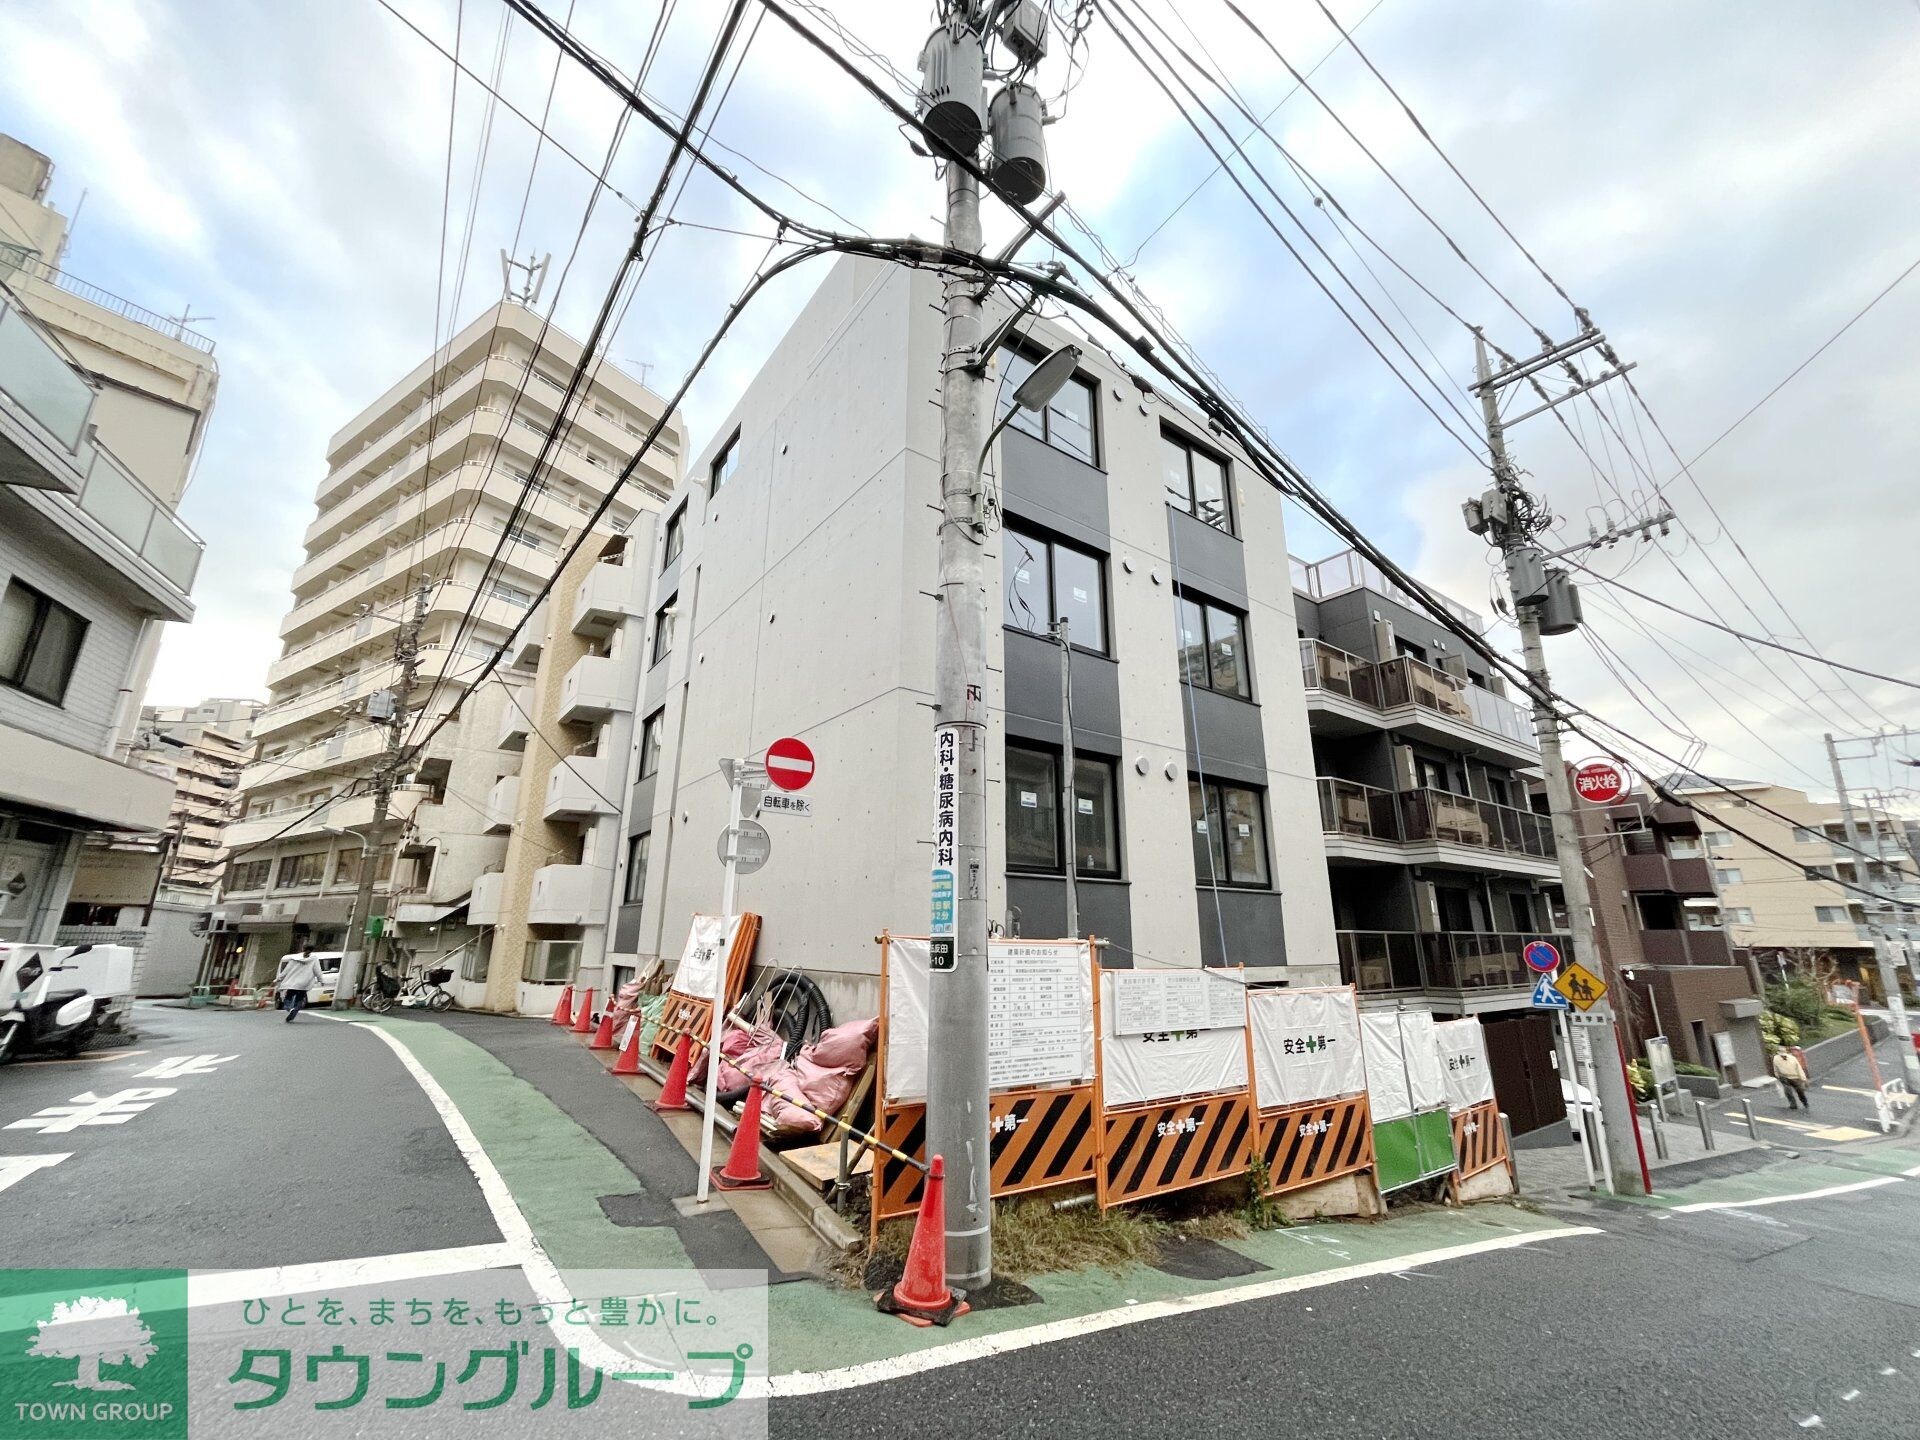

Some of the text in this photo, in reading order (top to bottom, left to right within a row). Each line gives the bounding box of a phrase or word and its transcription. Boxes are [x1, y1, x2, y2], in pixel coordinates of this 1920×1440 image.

[1578, 773, 1619, 792] 消火栓
[764, 796, 810, 811] 自転車を除く
[938, 732, 954, 866] 内科・糖尿病内科
[1008, 948, 1058, 956] 建築計画のお知らせ
